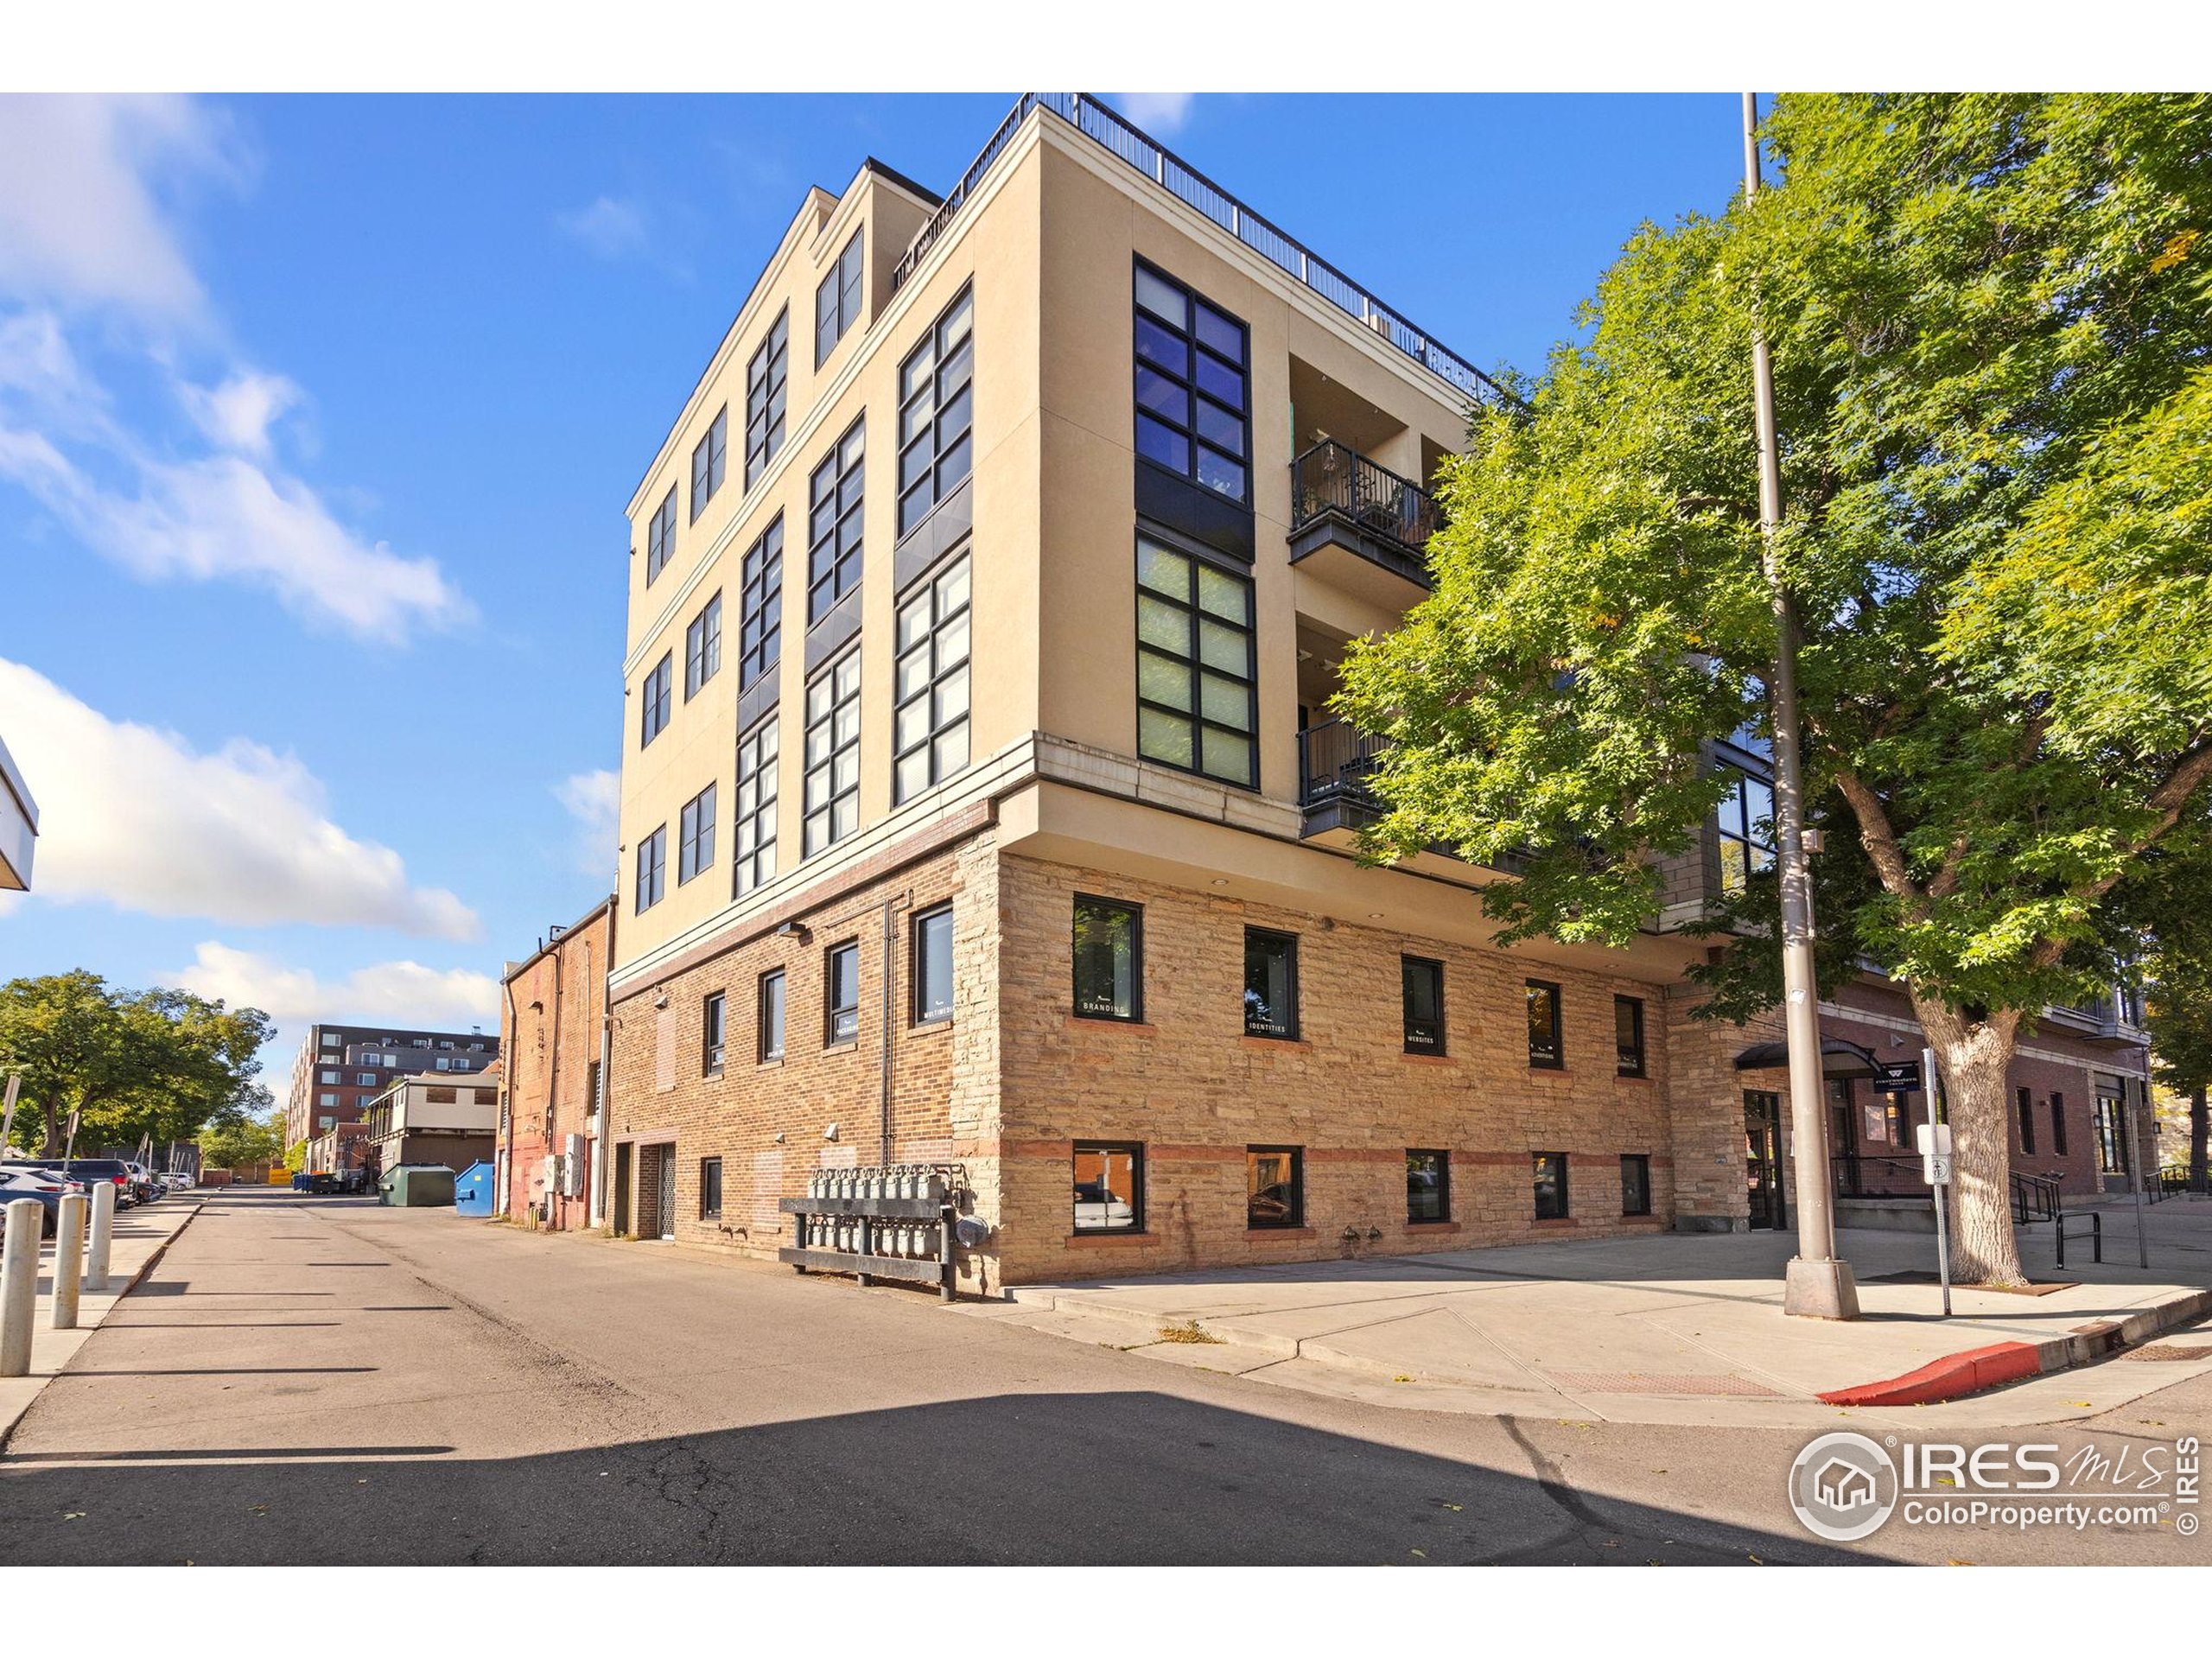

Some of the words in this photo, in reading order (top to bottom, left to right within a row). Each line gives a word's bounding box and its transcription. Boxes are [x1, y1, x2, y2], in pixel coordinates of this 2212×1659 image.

[924, 1006, 953, 1019] MULTIMEDI
[1083, 1002, 1124, 1014] BRANDING
[1249, 1022, 1286, 1033] IDENTITIES
